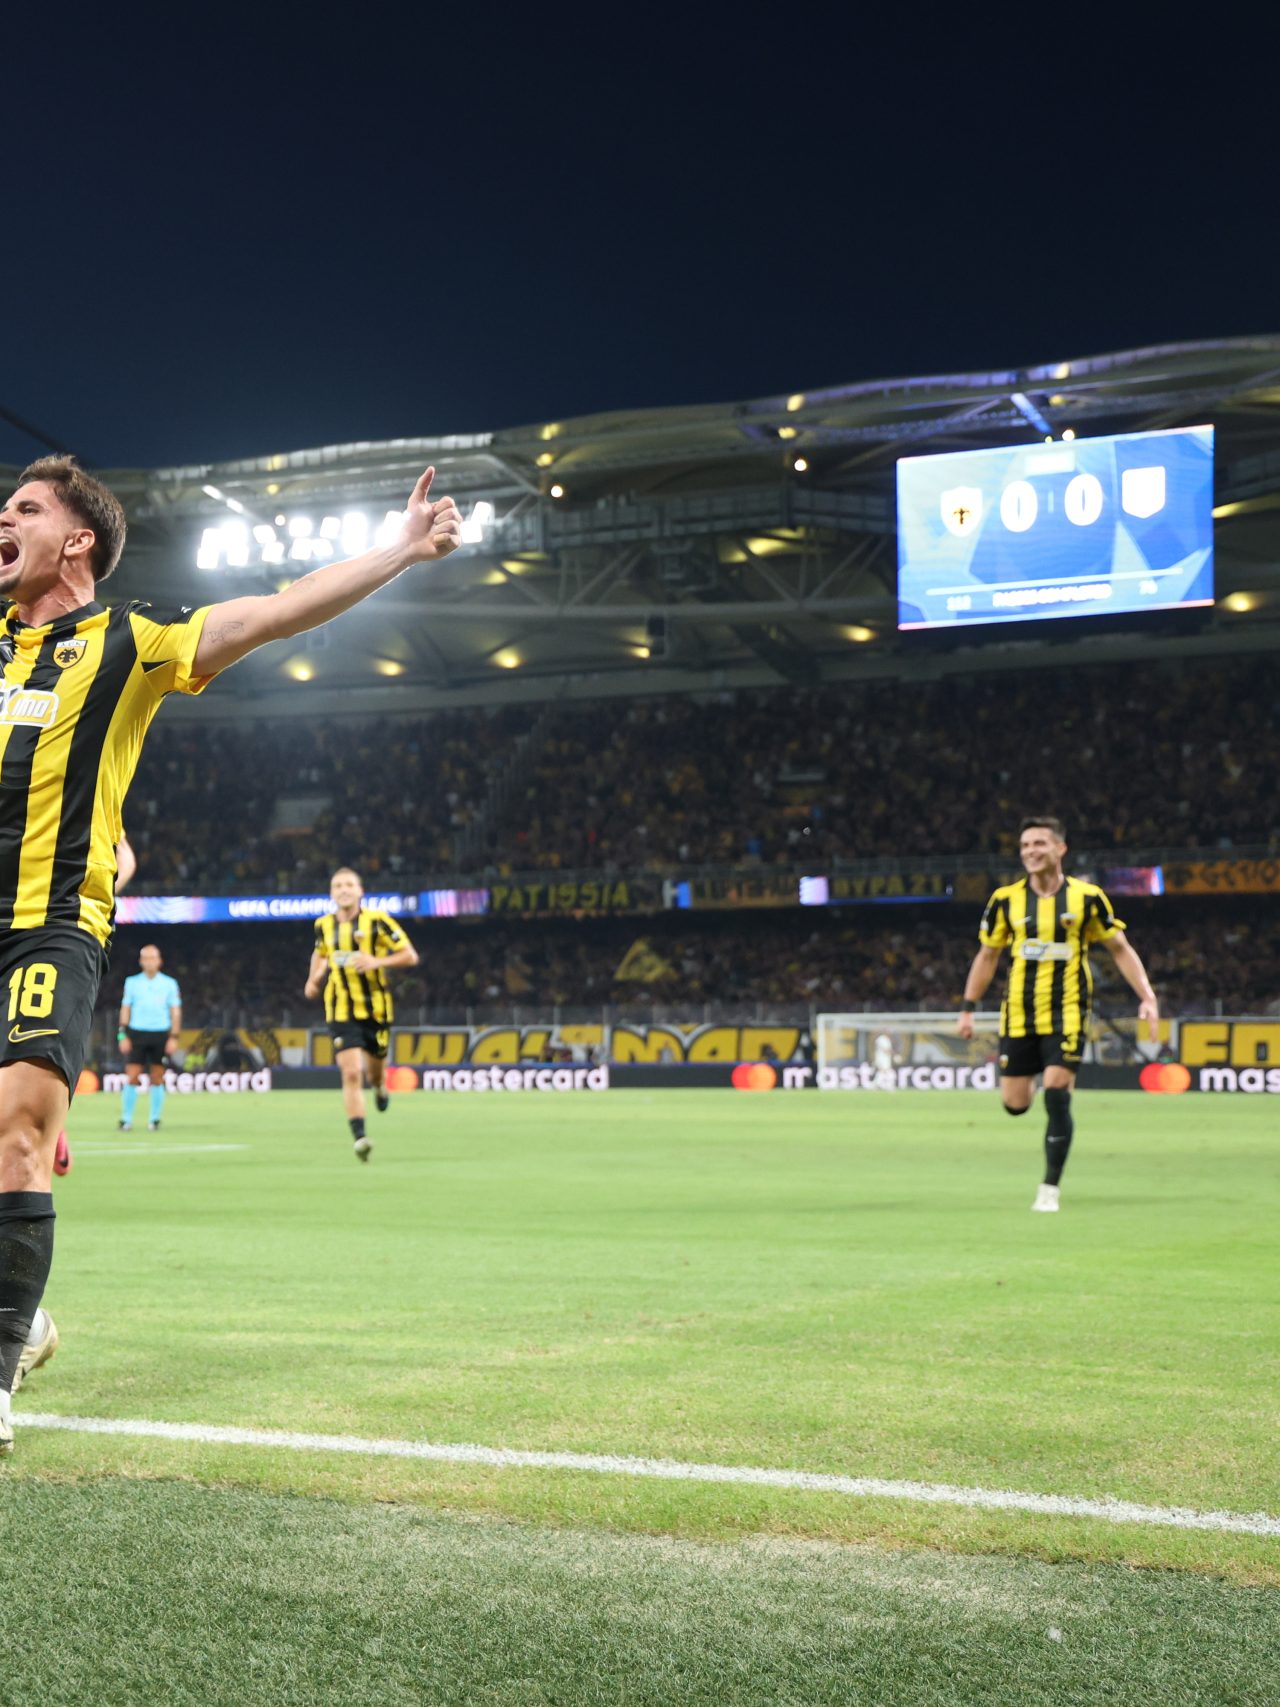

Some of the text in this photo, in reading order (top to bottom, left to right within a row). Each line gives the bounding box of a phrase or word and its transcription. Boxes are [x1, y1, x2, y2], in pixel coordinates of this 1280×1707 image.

[270, 899, 337, 916] CHAMPIO
[7, 962, 58, 1022] 18
[104, 1068, 272, 1093] matercard
[423, 1064, 609, 1091] mastercard
